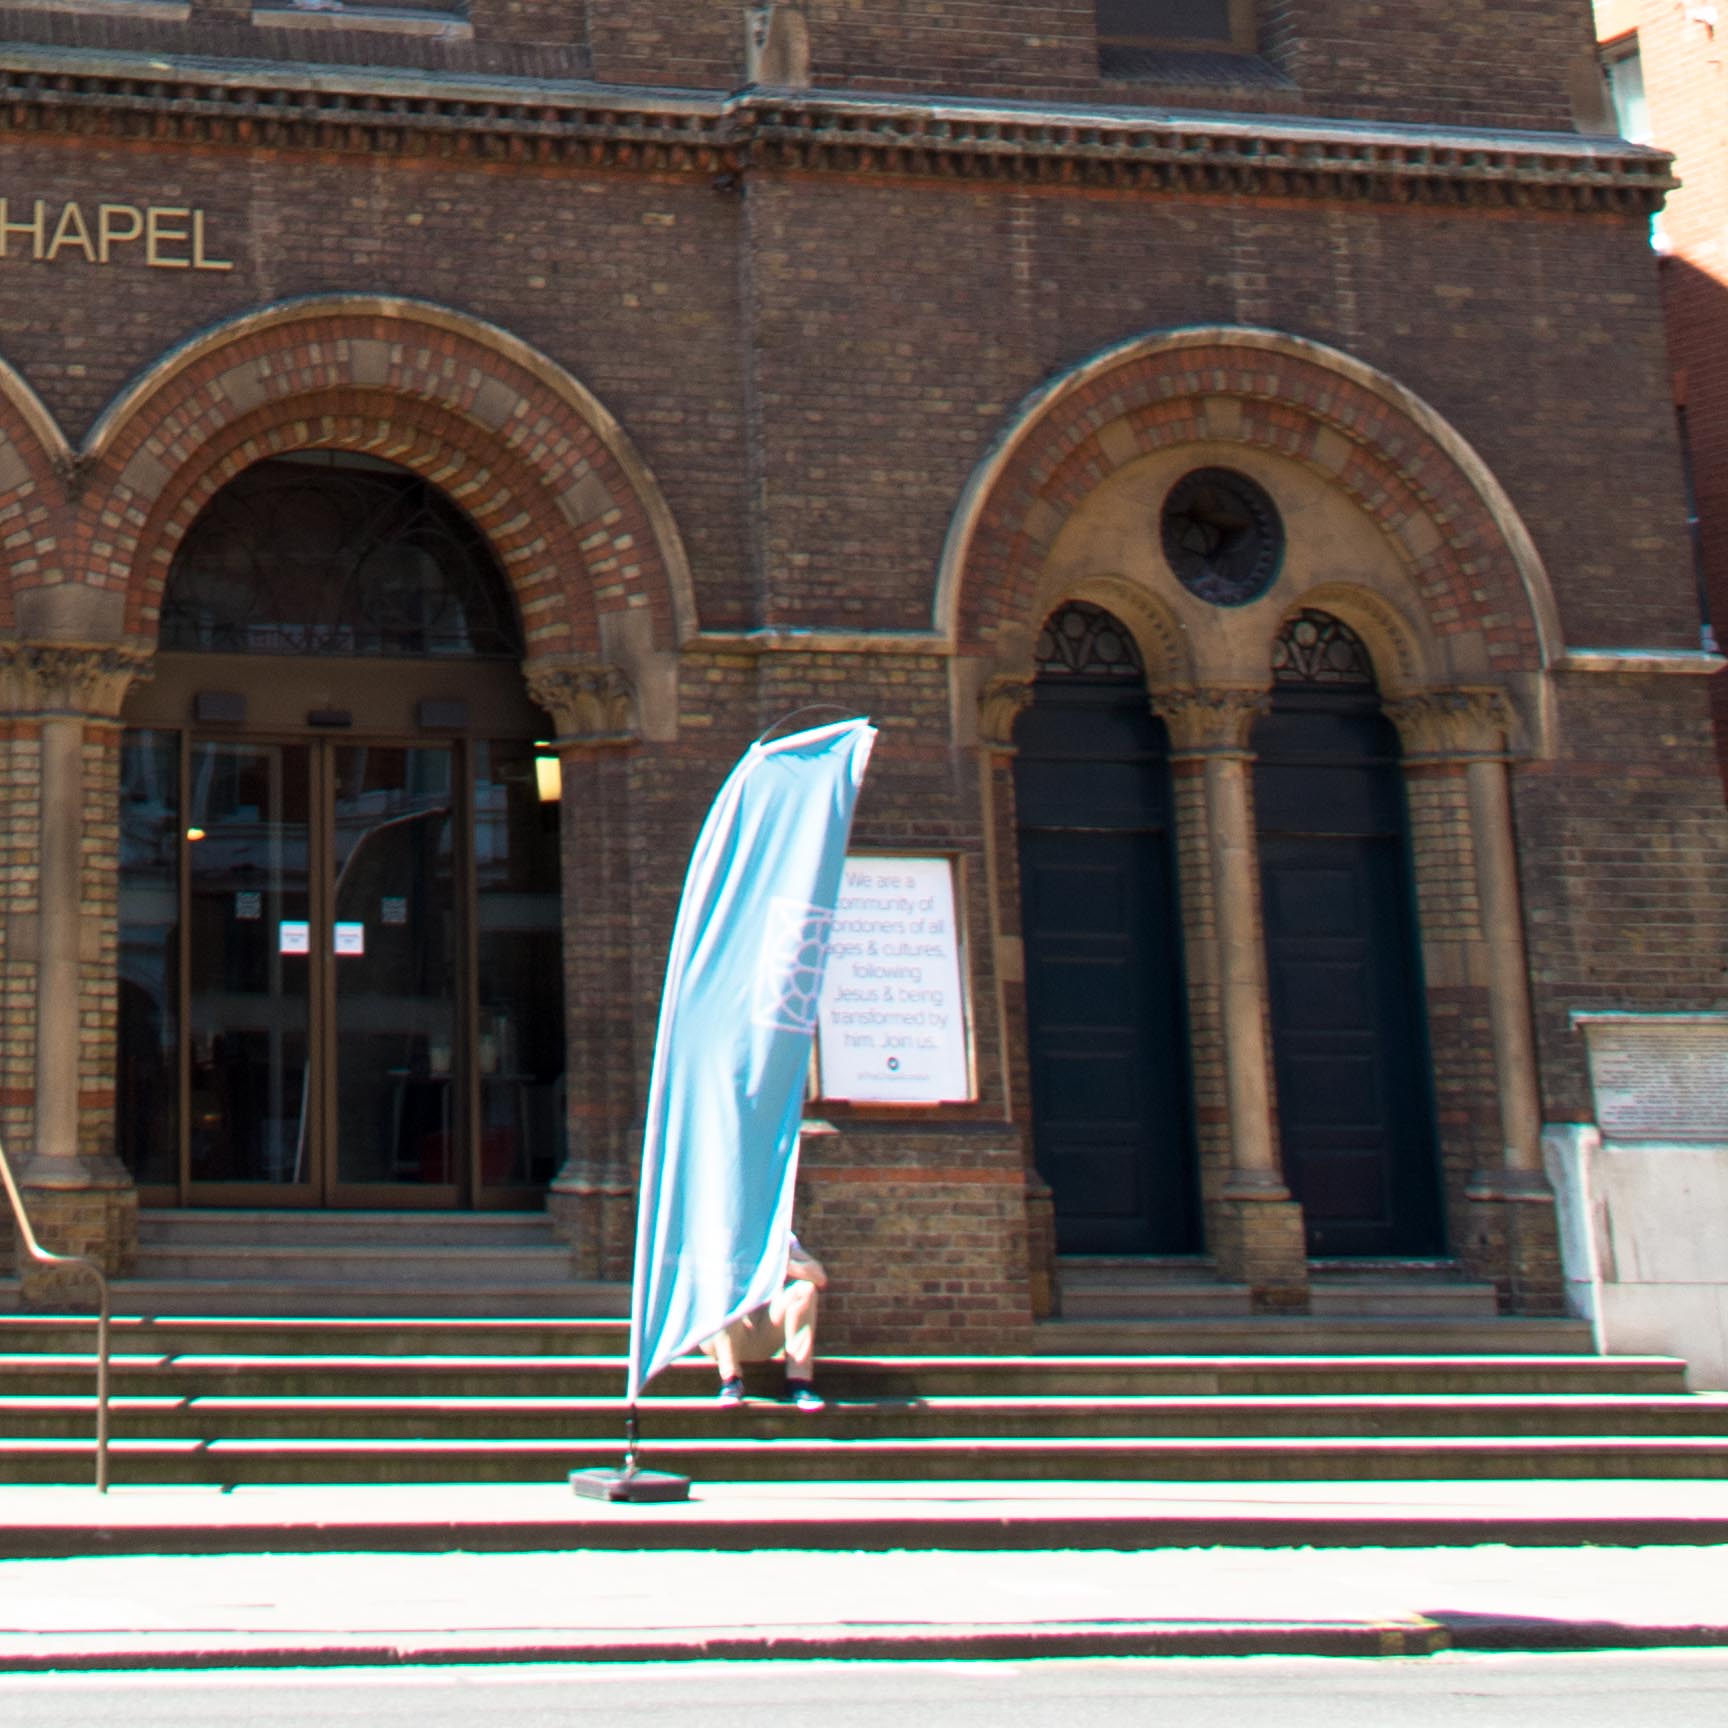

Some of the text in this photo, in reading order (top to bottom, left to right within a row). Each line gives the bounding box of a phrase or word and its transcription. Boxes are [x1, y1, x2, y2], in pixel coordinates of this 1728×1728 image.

[846, 872, 916, 889] We are a
[838, 896, 934, 915] ommunity of
[830, 917, 944, 934] ondoners of all
[867, 940, 879, 956] &
[852, 962, 922, 983] following
[834, 985, 944, 1006] Jesus & being
[830, 1009, 949, 1029] transformed by
[881, 1034, 913, 1049] Join
